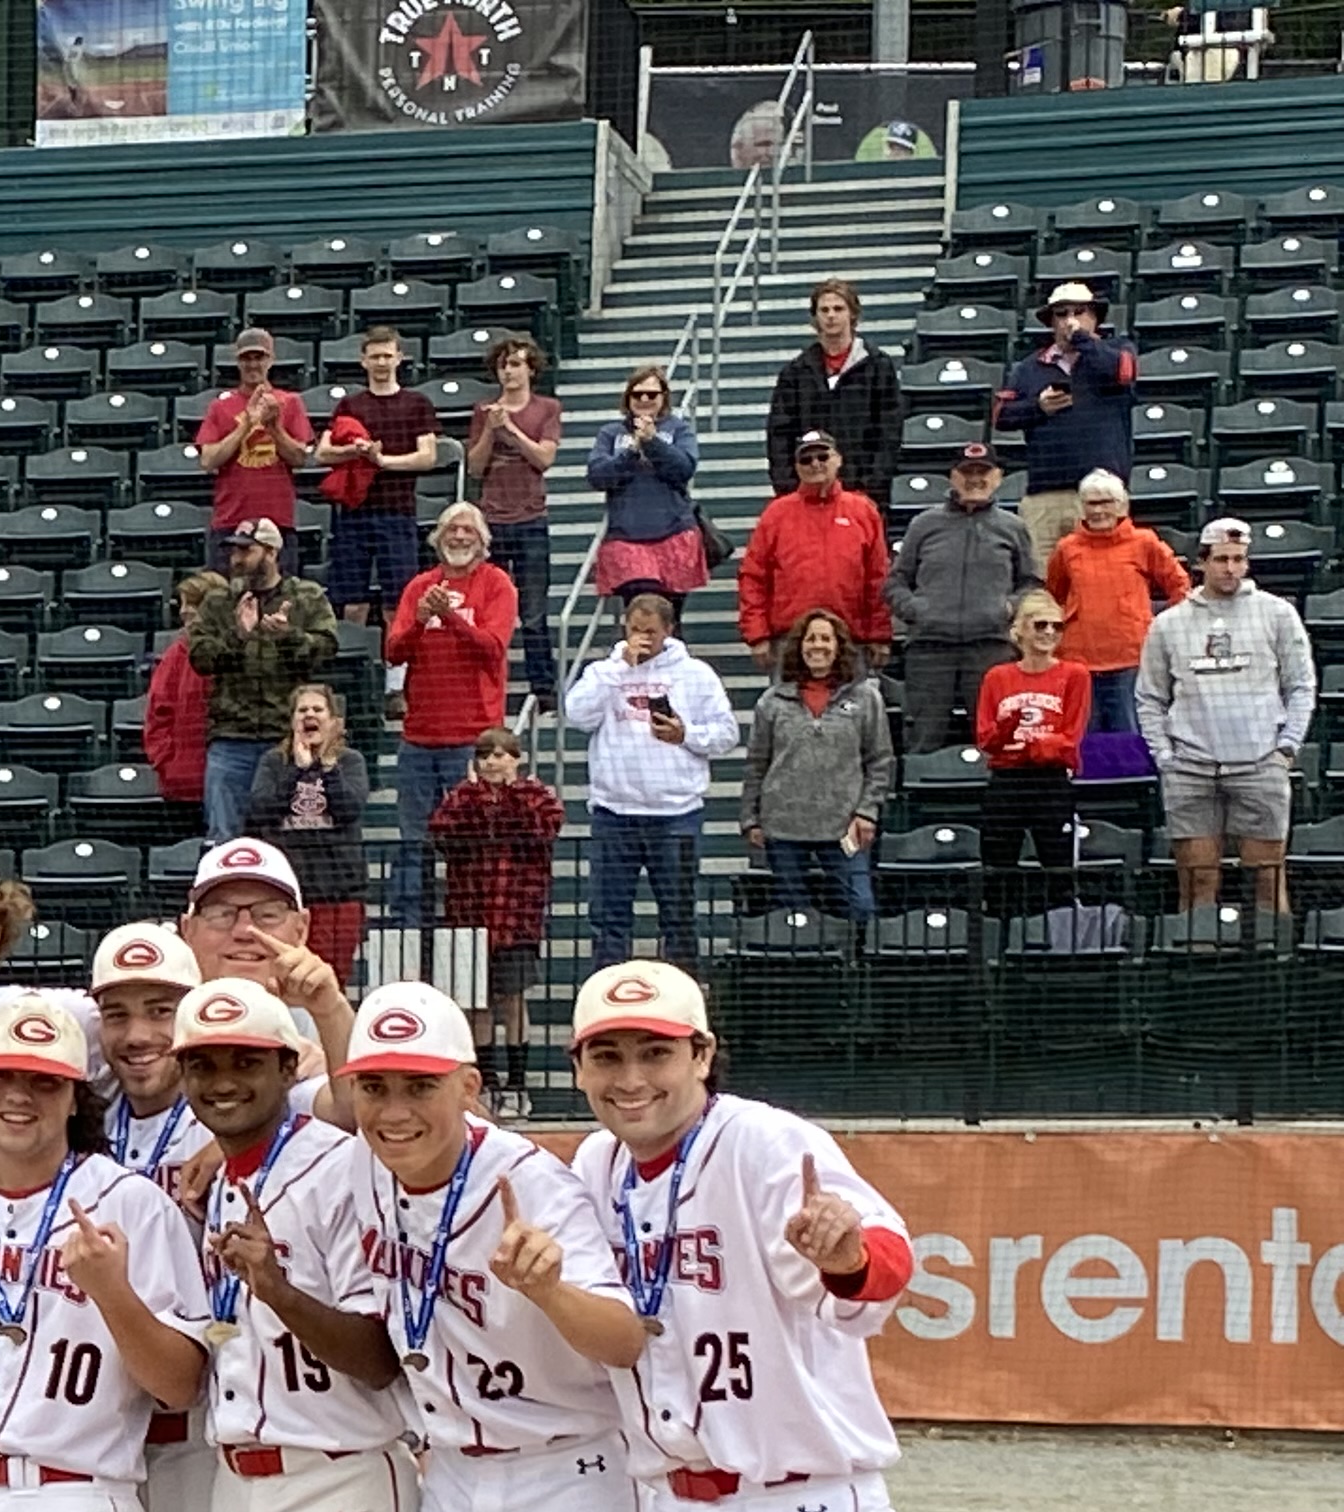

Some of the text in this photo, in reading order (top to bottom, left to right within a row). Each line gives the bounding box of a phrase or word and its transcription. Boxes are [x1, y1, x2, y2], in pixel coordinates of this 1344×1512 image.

[219, 845, 262, 869] G
[115, 940, 158, 969] G
[604, 977, 651, 1004] G
[197, 997, 244, 1023] G
[12, 1018, 56, 1045] G
[371, 1011, 419, 1040] G
[44, 1337, 103, 1406] 10
[693, 1331, 754, 1403] 25
